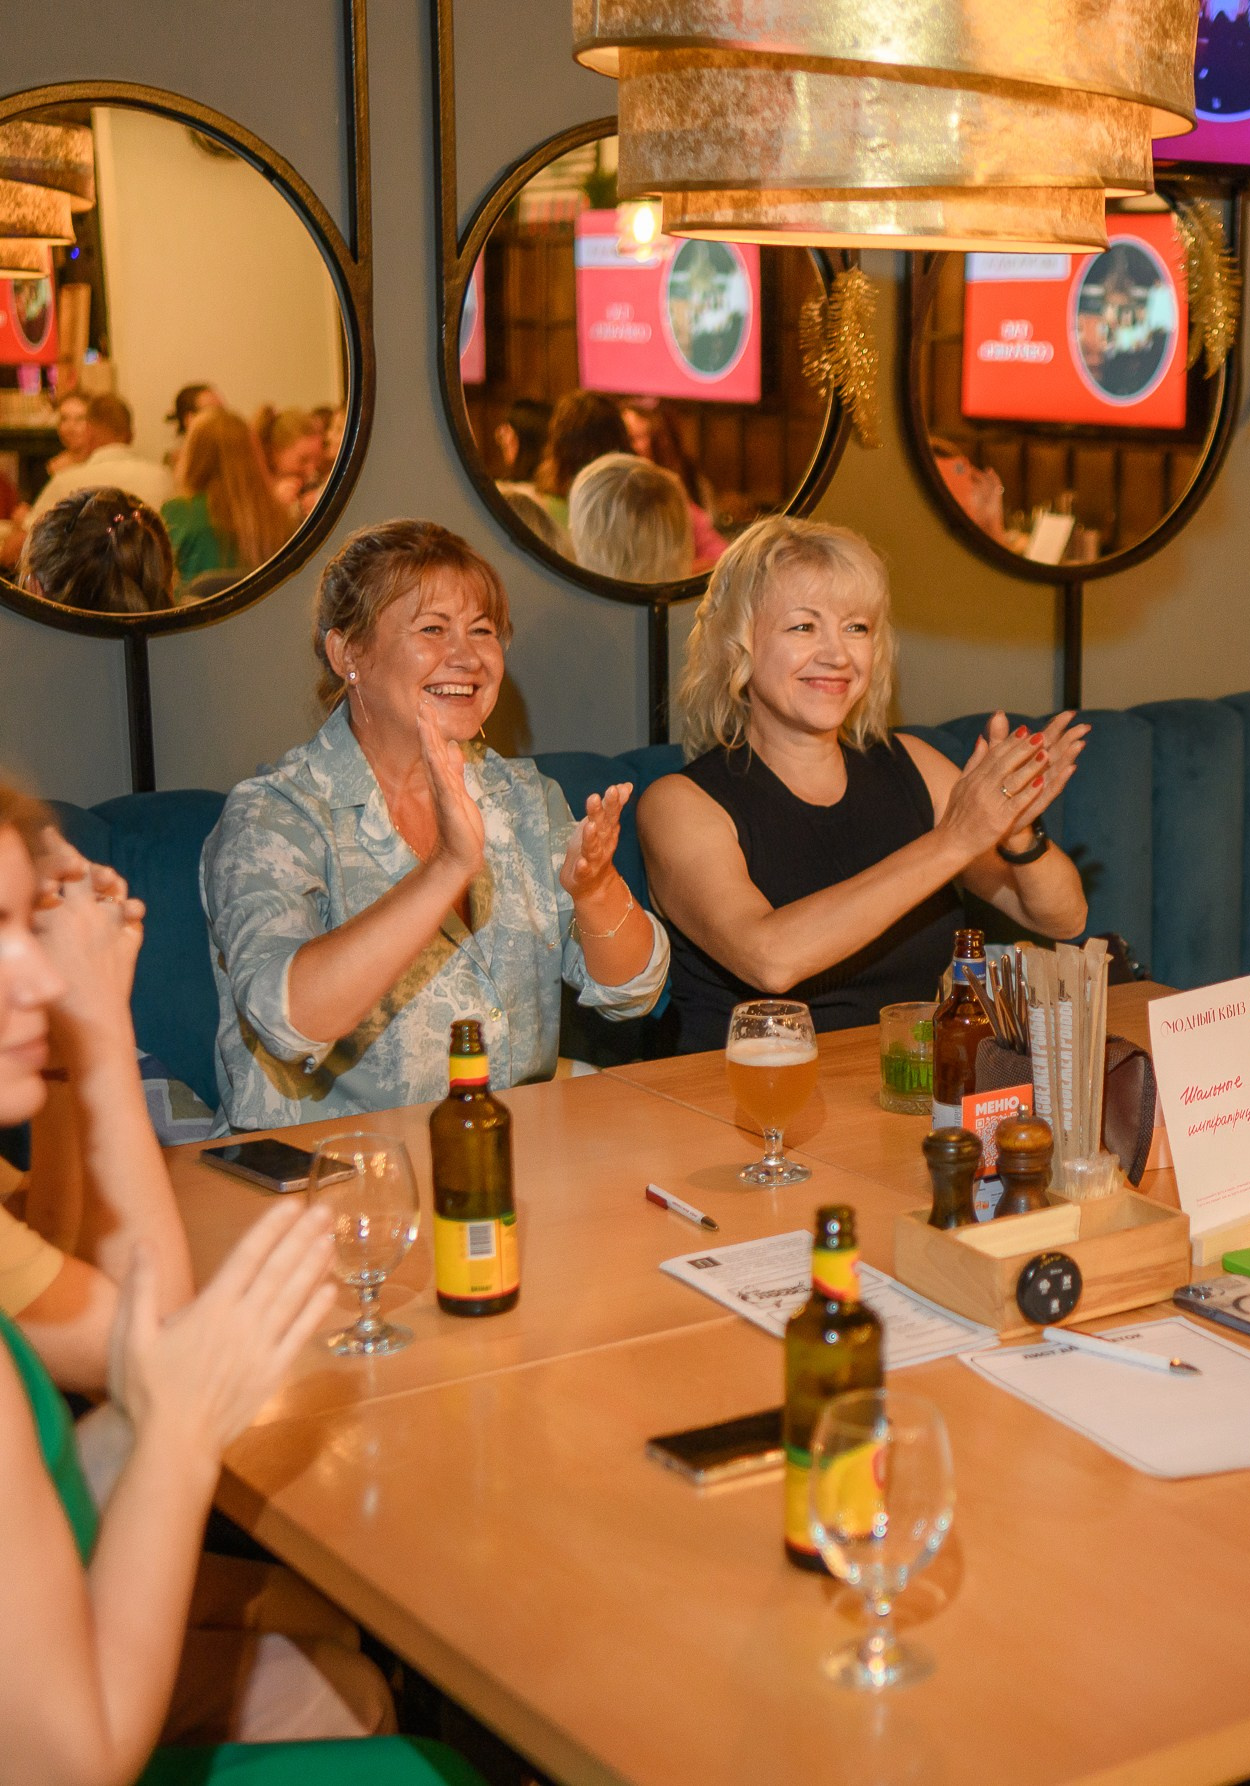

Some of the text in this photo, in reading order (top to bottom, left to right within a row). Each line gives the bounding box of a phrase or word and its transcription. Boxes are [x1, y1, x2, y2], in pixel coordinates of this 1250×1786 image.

[1161, 1001, 1246, 1037] МОДНЫЙ КВИЗ
[975, 1096, 1020, 1116] МЕНЮ
